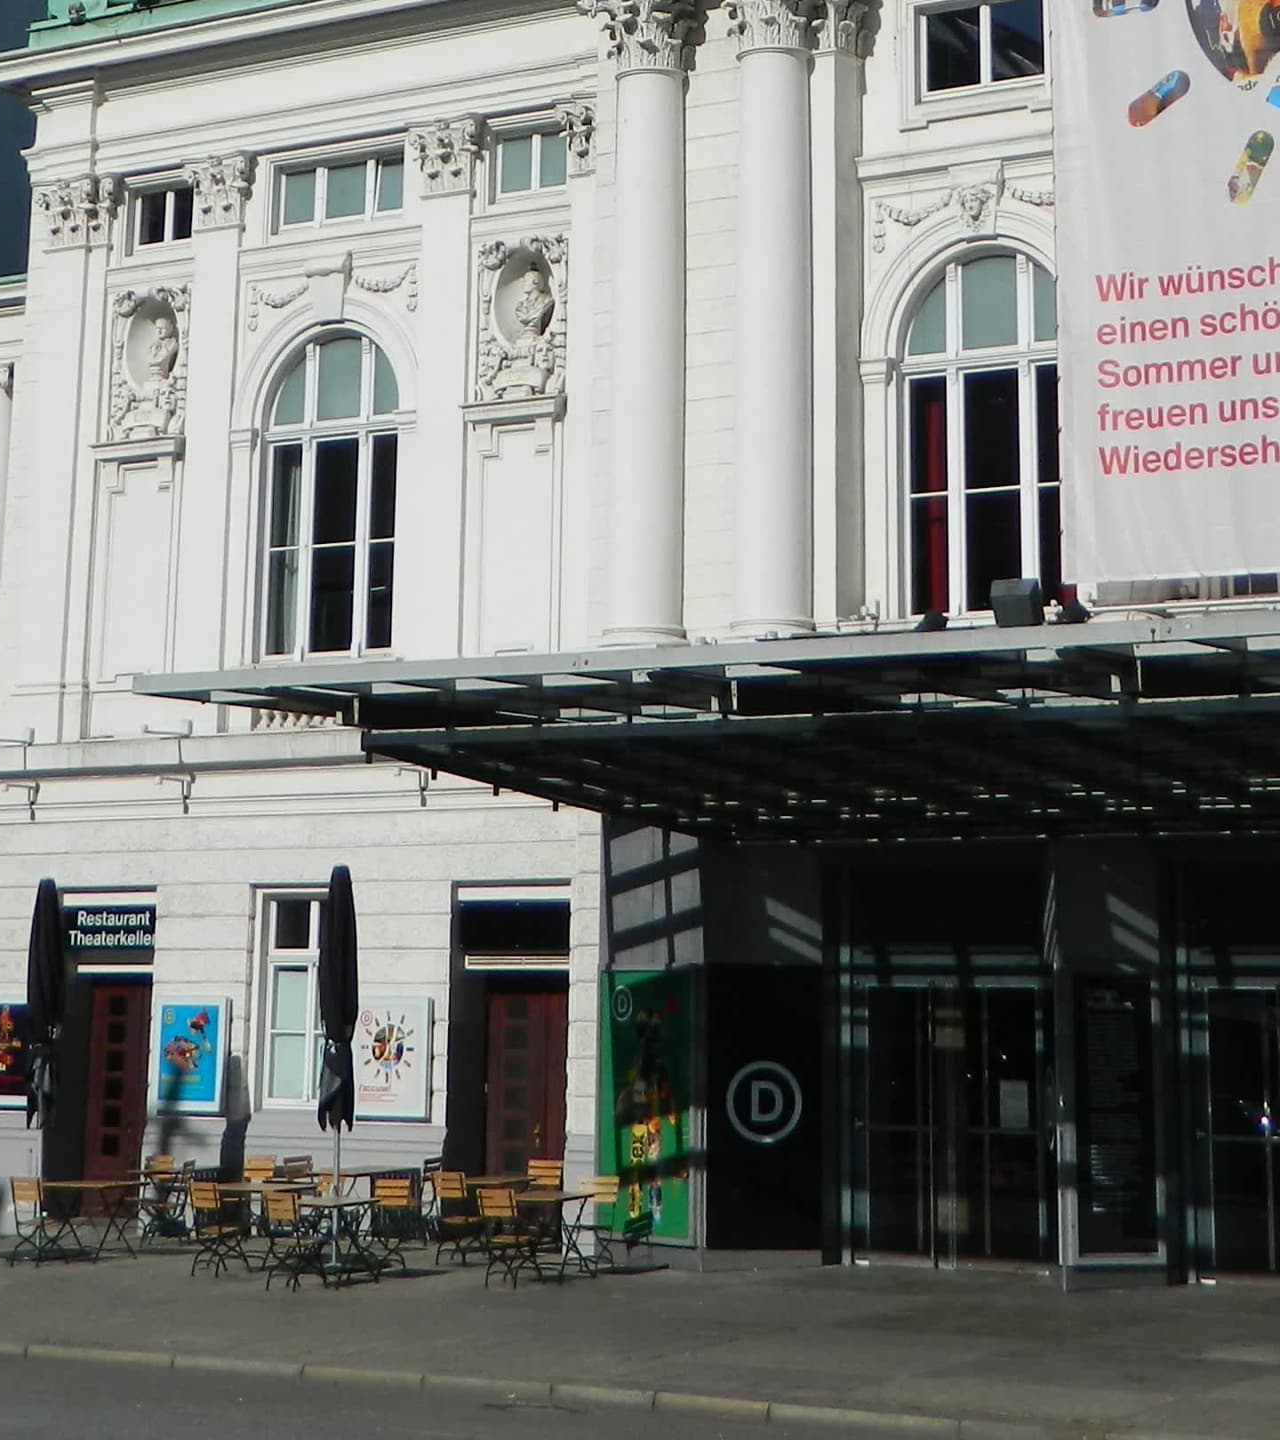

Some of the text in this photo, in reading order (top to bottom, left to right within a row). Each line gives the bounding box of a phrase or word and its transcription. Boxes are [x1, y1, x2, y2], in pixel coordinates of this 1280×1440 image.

[1095, 272, 1149, 302] Wir
[1096, 316, 1190, 345] einen
[1097, 354, 1243, 389] Sommer
[1097, 402, 1208, 432] freuen
[1218, 394, 1280, 423] uns
[77, 910, 151, 927] Restaurant
